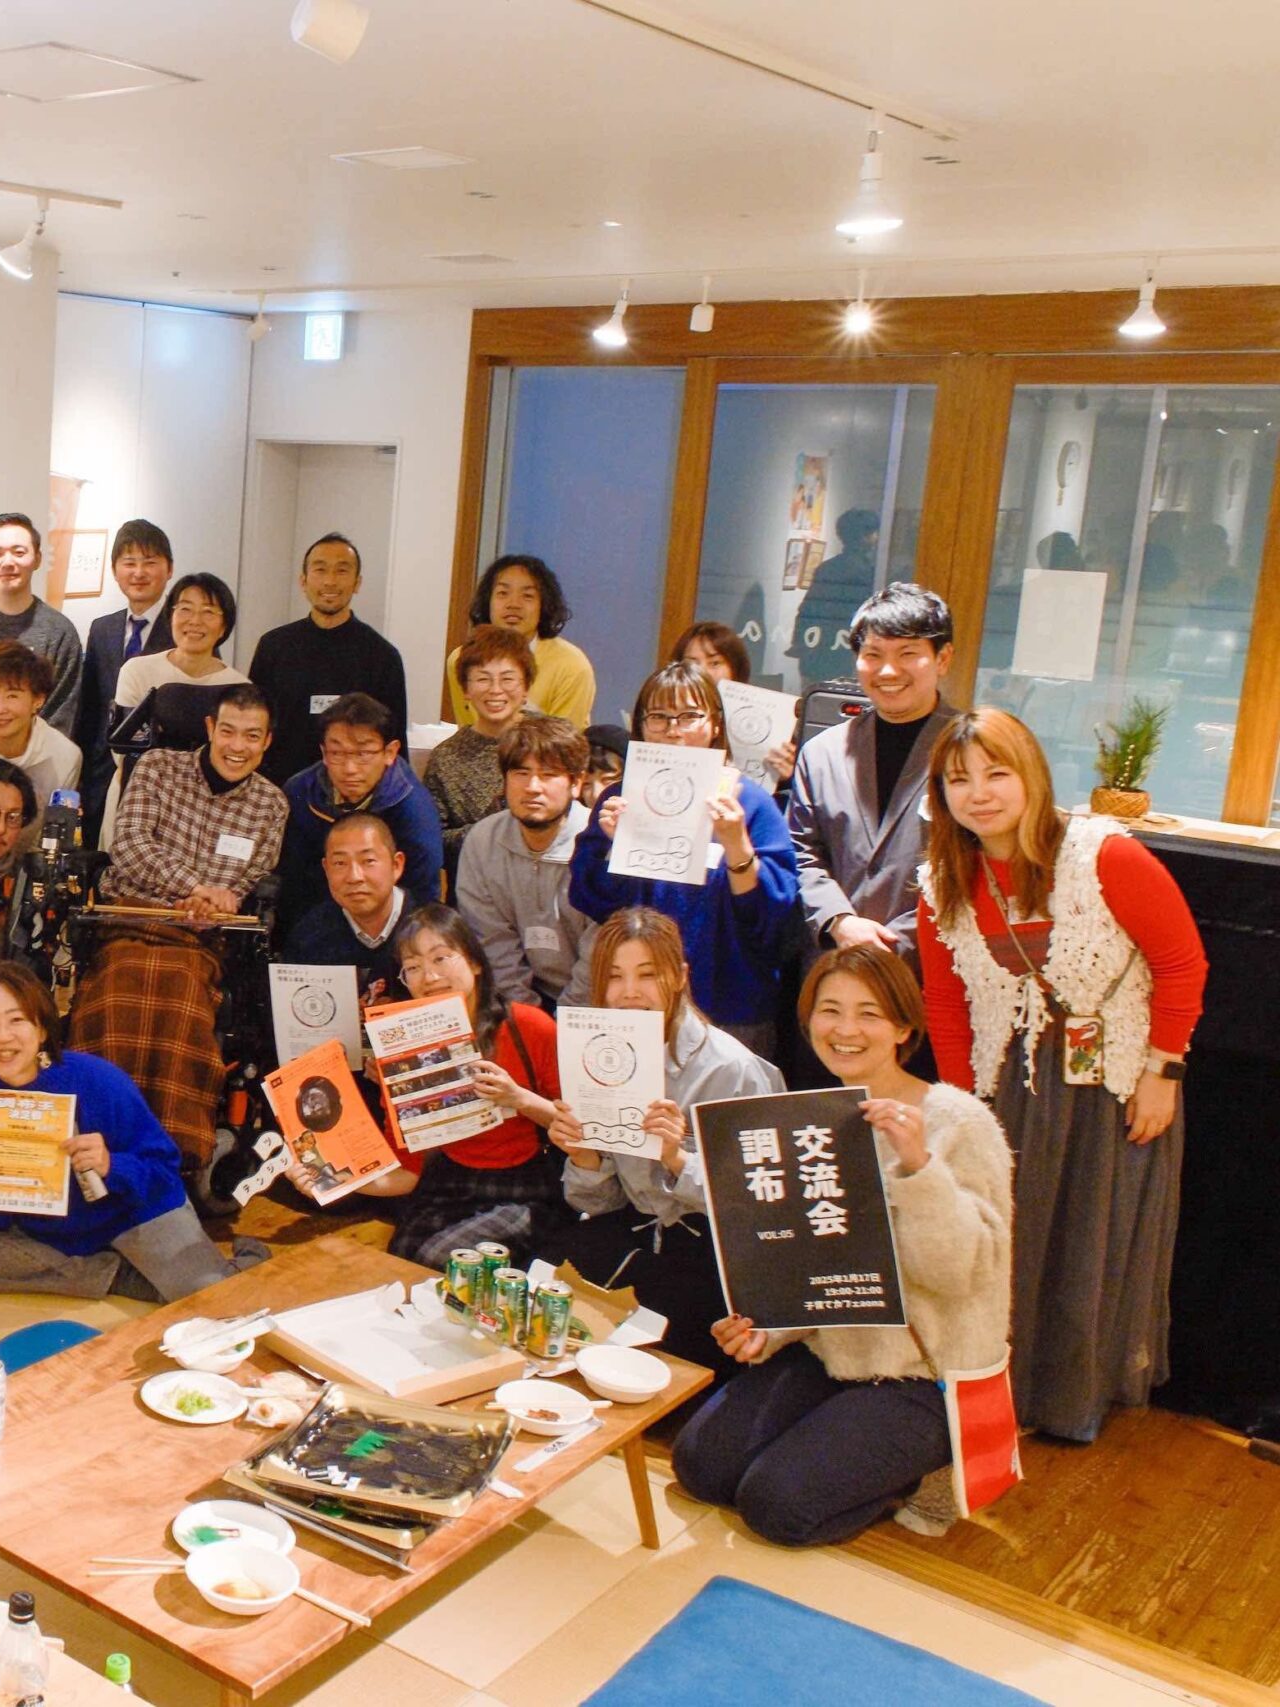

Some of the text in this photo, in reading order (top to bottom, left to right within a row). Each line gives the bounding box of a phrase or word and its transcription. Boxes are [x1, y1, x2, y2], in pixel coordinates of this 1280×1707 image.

[738, 1127, 786, 1202] 調布
[792, 1124, 848, 1236] 交流会
[809, 1273, 881, 1285] 2025年1月17日
